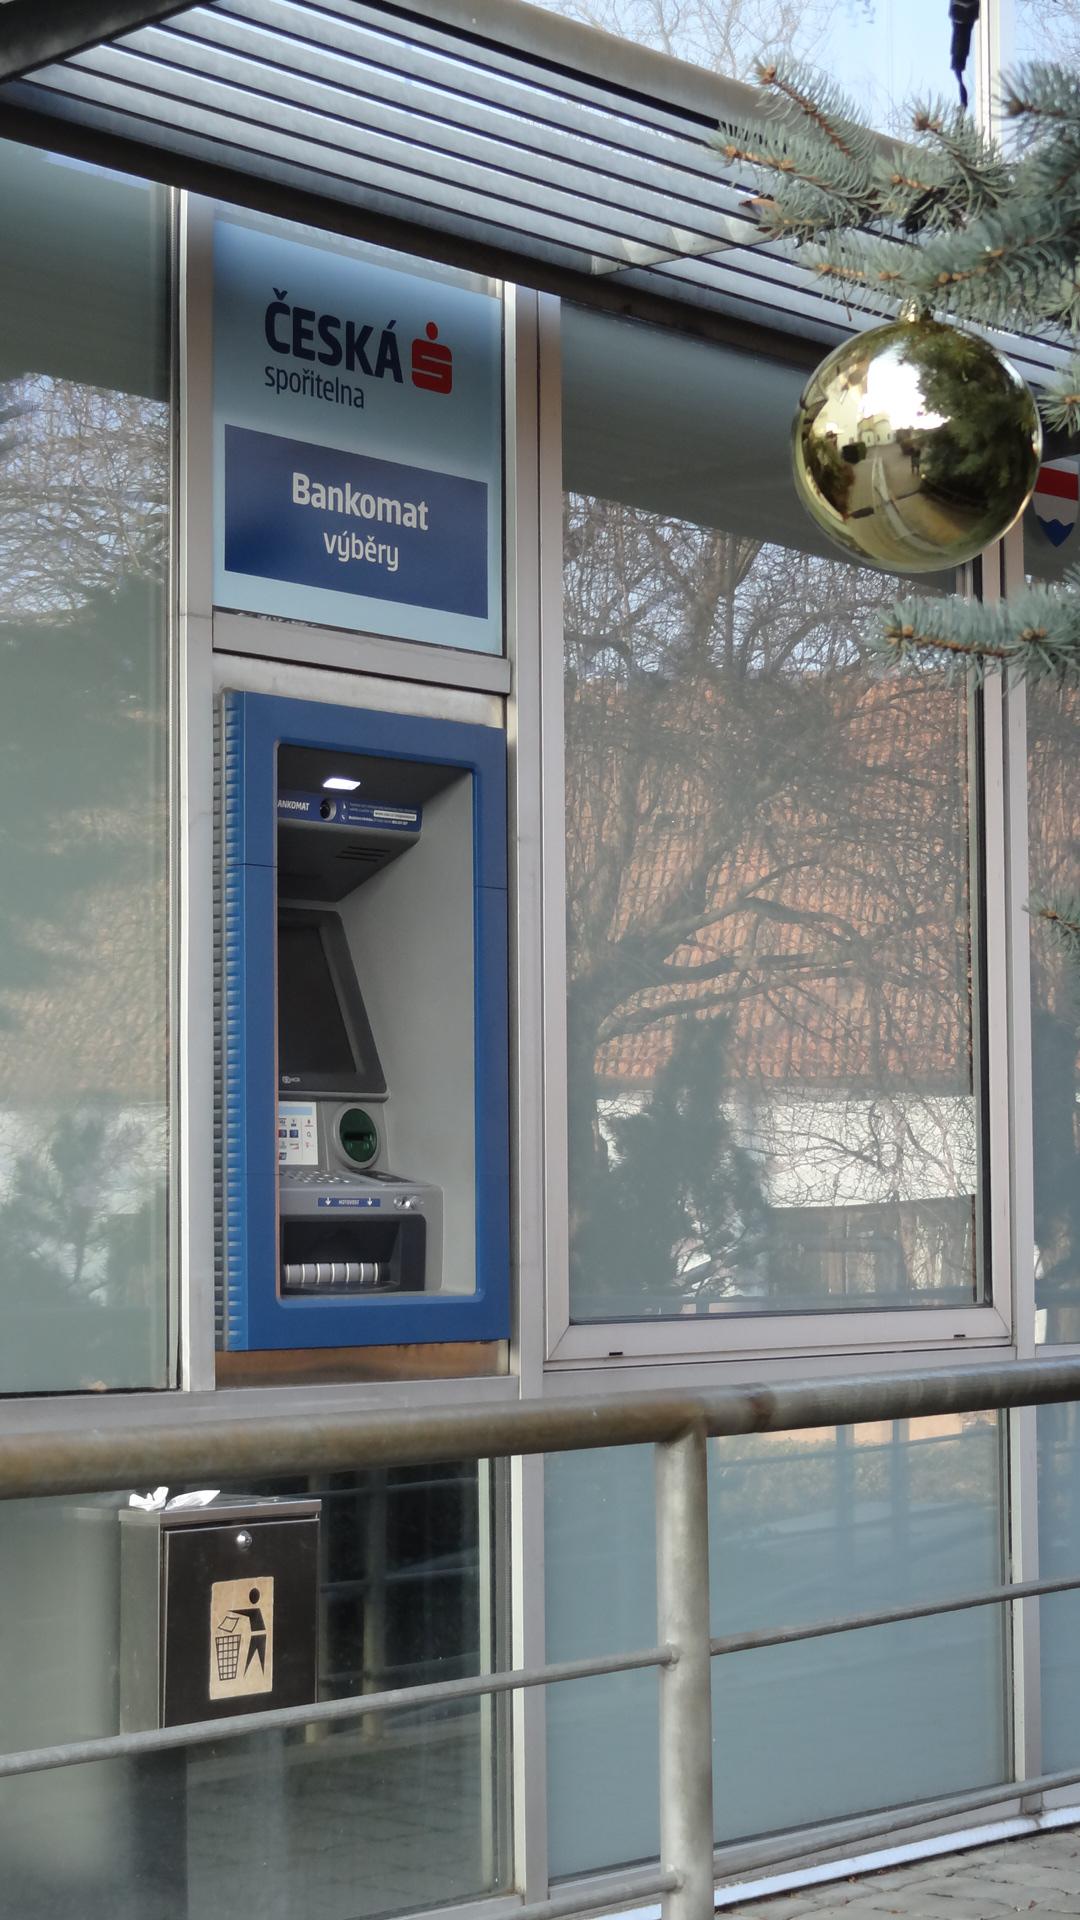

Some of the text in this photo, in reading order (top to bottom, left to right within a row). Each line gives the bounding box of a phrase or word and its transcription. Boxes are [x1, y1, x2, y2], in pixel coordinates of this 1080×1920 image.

[264, 287, 403, 384] ČESKÁ
[264, 365, 365, 409] spořitelna
[292, 472, 428, 531] Bankomat
[323, 530, 399, 572] výběry
[277, 799, 310, 811] ANKOMAT
